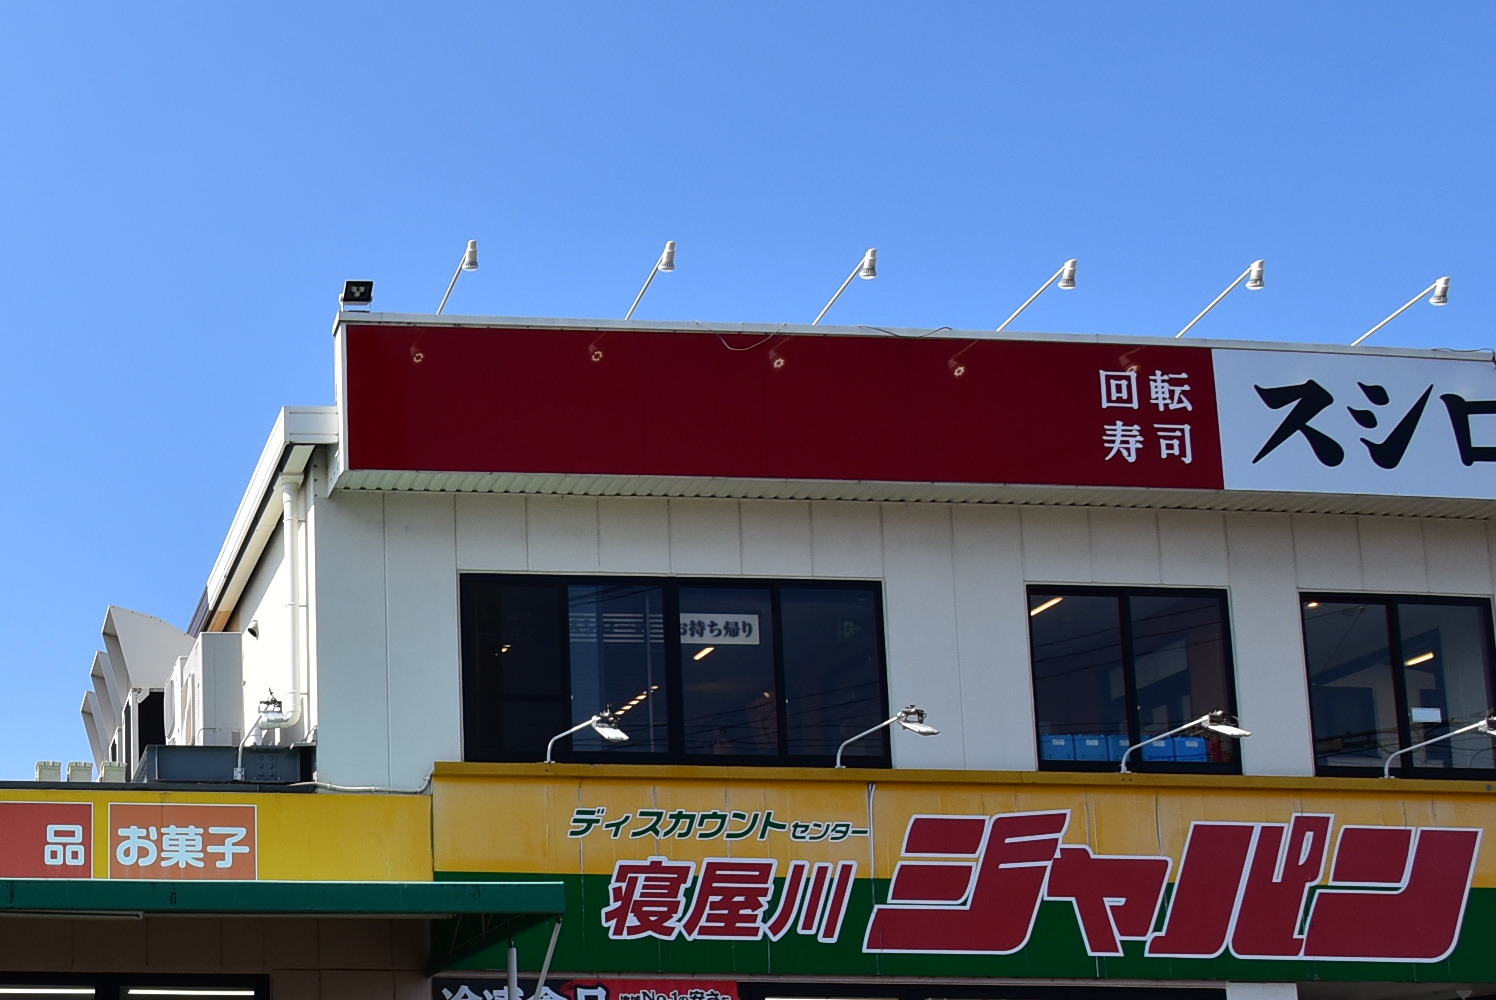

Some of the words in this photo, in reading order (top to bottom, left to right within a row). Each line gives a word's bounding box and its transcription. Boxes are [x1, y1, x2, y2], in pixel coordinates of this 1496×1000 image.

[1099, 369, 1193, 412] 回転
[1102, 420, 1193, 464] 寿司
[116, 825, 250, 869] お菓子
[601, 855, 858, 943] 寝屋川
[862, 808, 1484, 963] ジャパン
